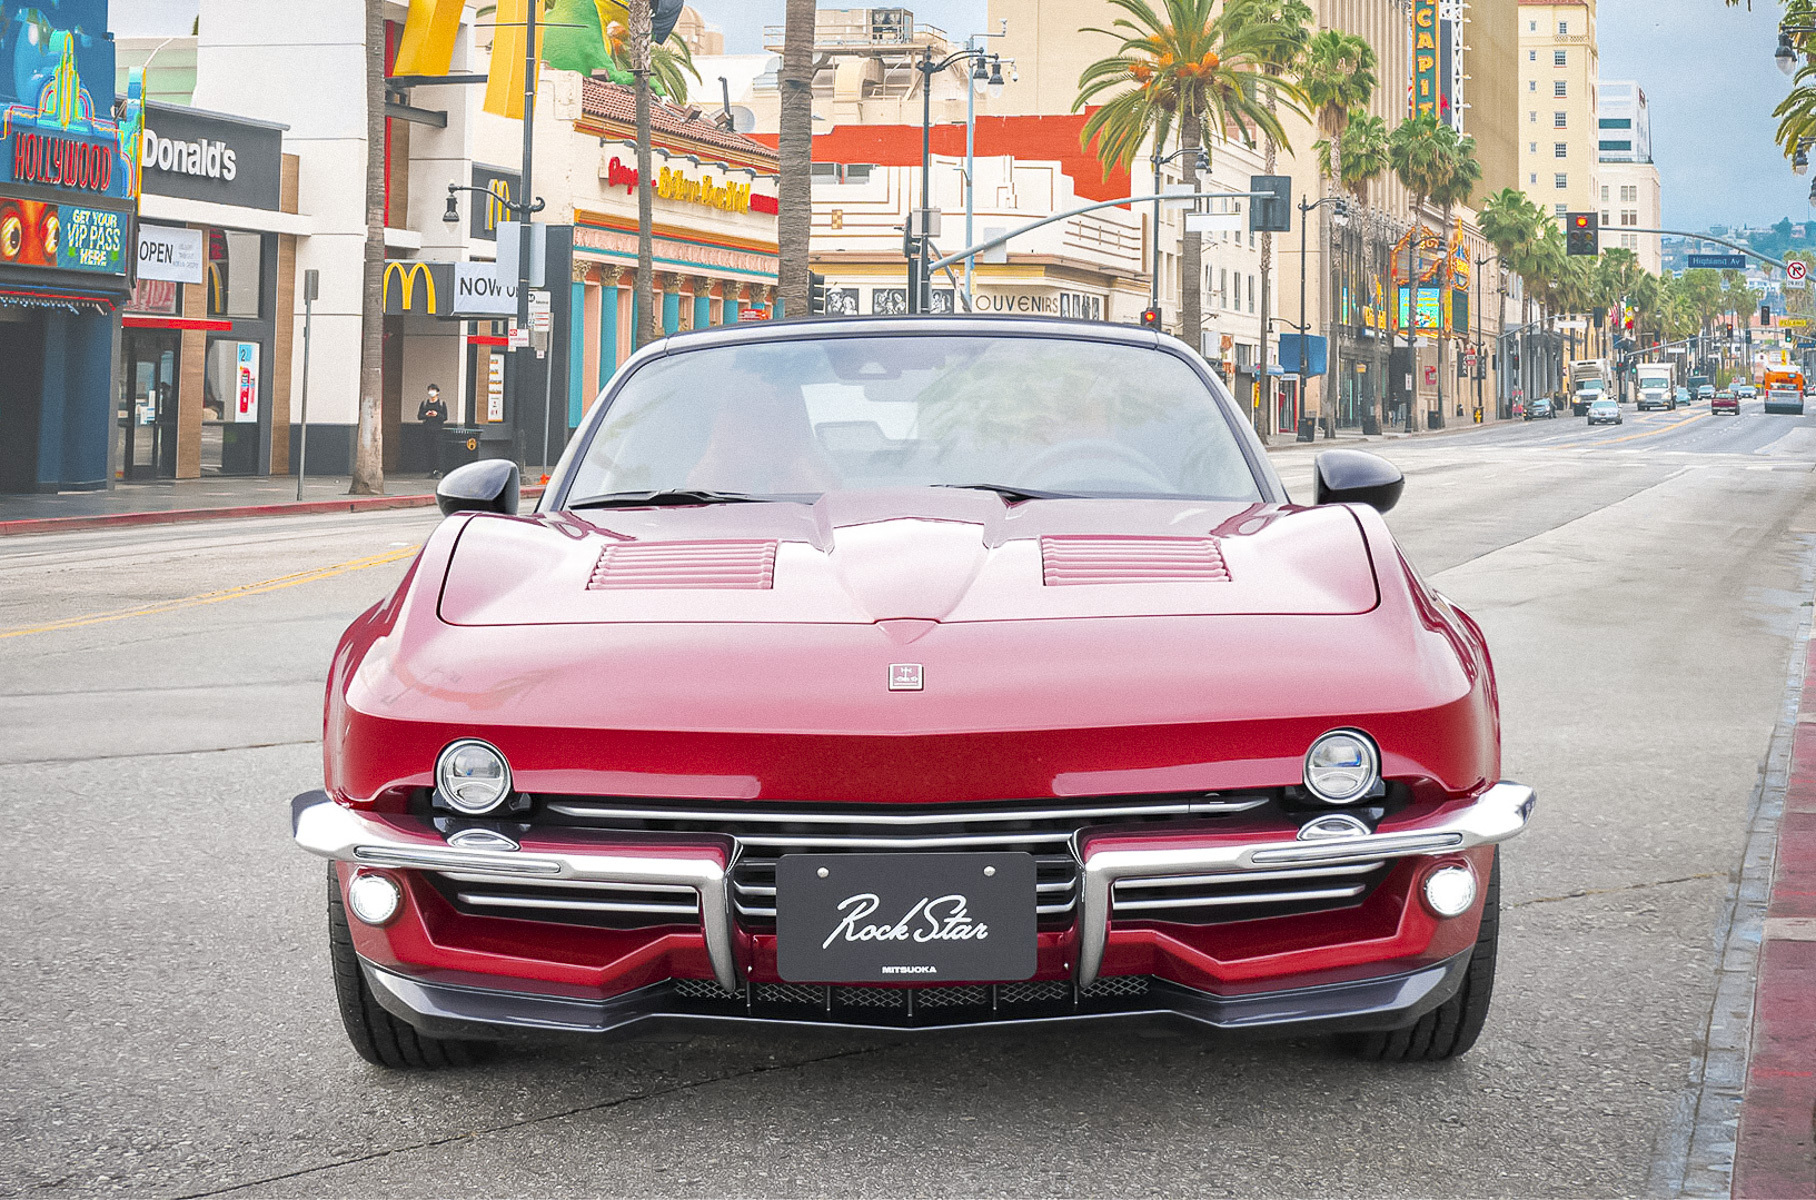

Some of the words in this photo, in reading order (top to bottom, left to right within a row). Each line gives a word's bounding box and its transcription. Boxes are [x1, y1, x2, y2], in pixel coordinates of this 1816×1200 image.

[14, 131, 112, 191] HOLLYWOOD
[72, 209, 91, 225] GET
[91, 210, 118, 229] YOUR
[67, 222, 88, 249] VIP
[89, 226, 121, 252] PASS
[79, 248, 107, 267] HERE
[139, 240, 174, 264] OPEN
[1693, 256, 1727, 266] Highland
[1730, 257, 1740, 265] Av
[460, 277, 502, 297] NOW
[822, 893, 929, 950] Rock
[913, 894, 989, 943] Star
[881, 966, 937, 974] MITSUOKA
